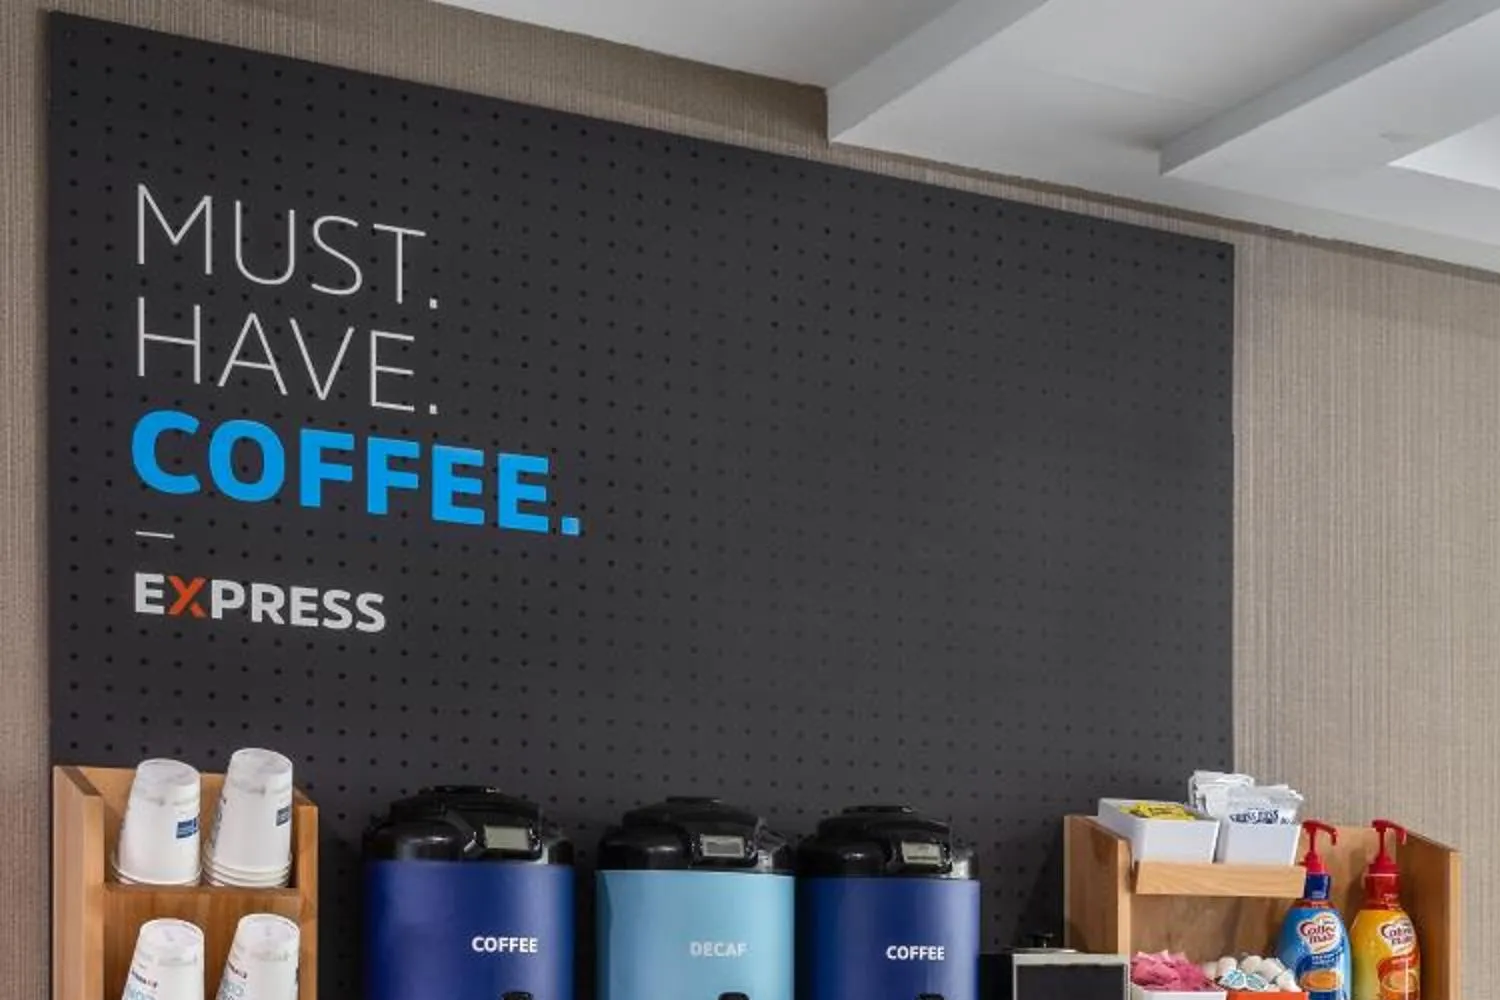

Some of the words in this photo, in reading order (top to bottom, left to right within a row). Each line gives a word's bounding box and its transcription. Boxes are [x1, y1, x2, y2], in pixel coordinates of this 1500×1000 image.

[137, 183, 438, 309] MUST.
[137, 297, 438, 415] HAVE.
[132, 410, 579, 536] COFFEE.
[134, 572, 386, 633] EXPRESS
[471, 936, 538, 954] COFFEE
[690, 940, 748, 957] DECAF
[886, 945, 945, 961] COFFEE
